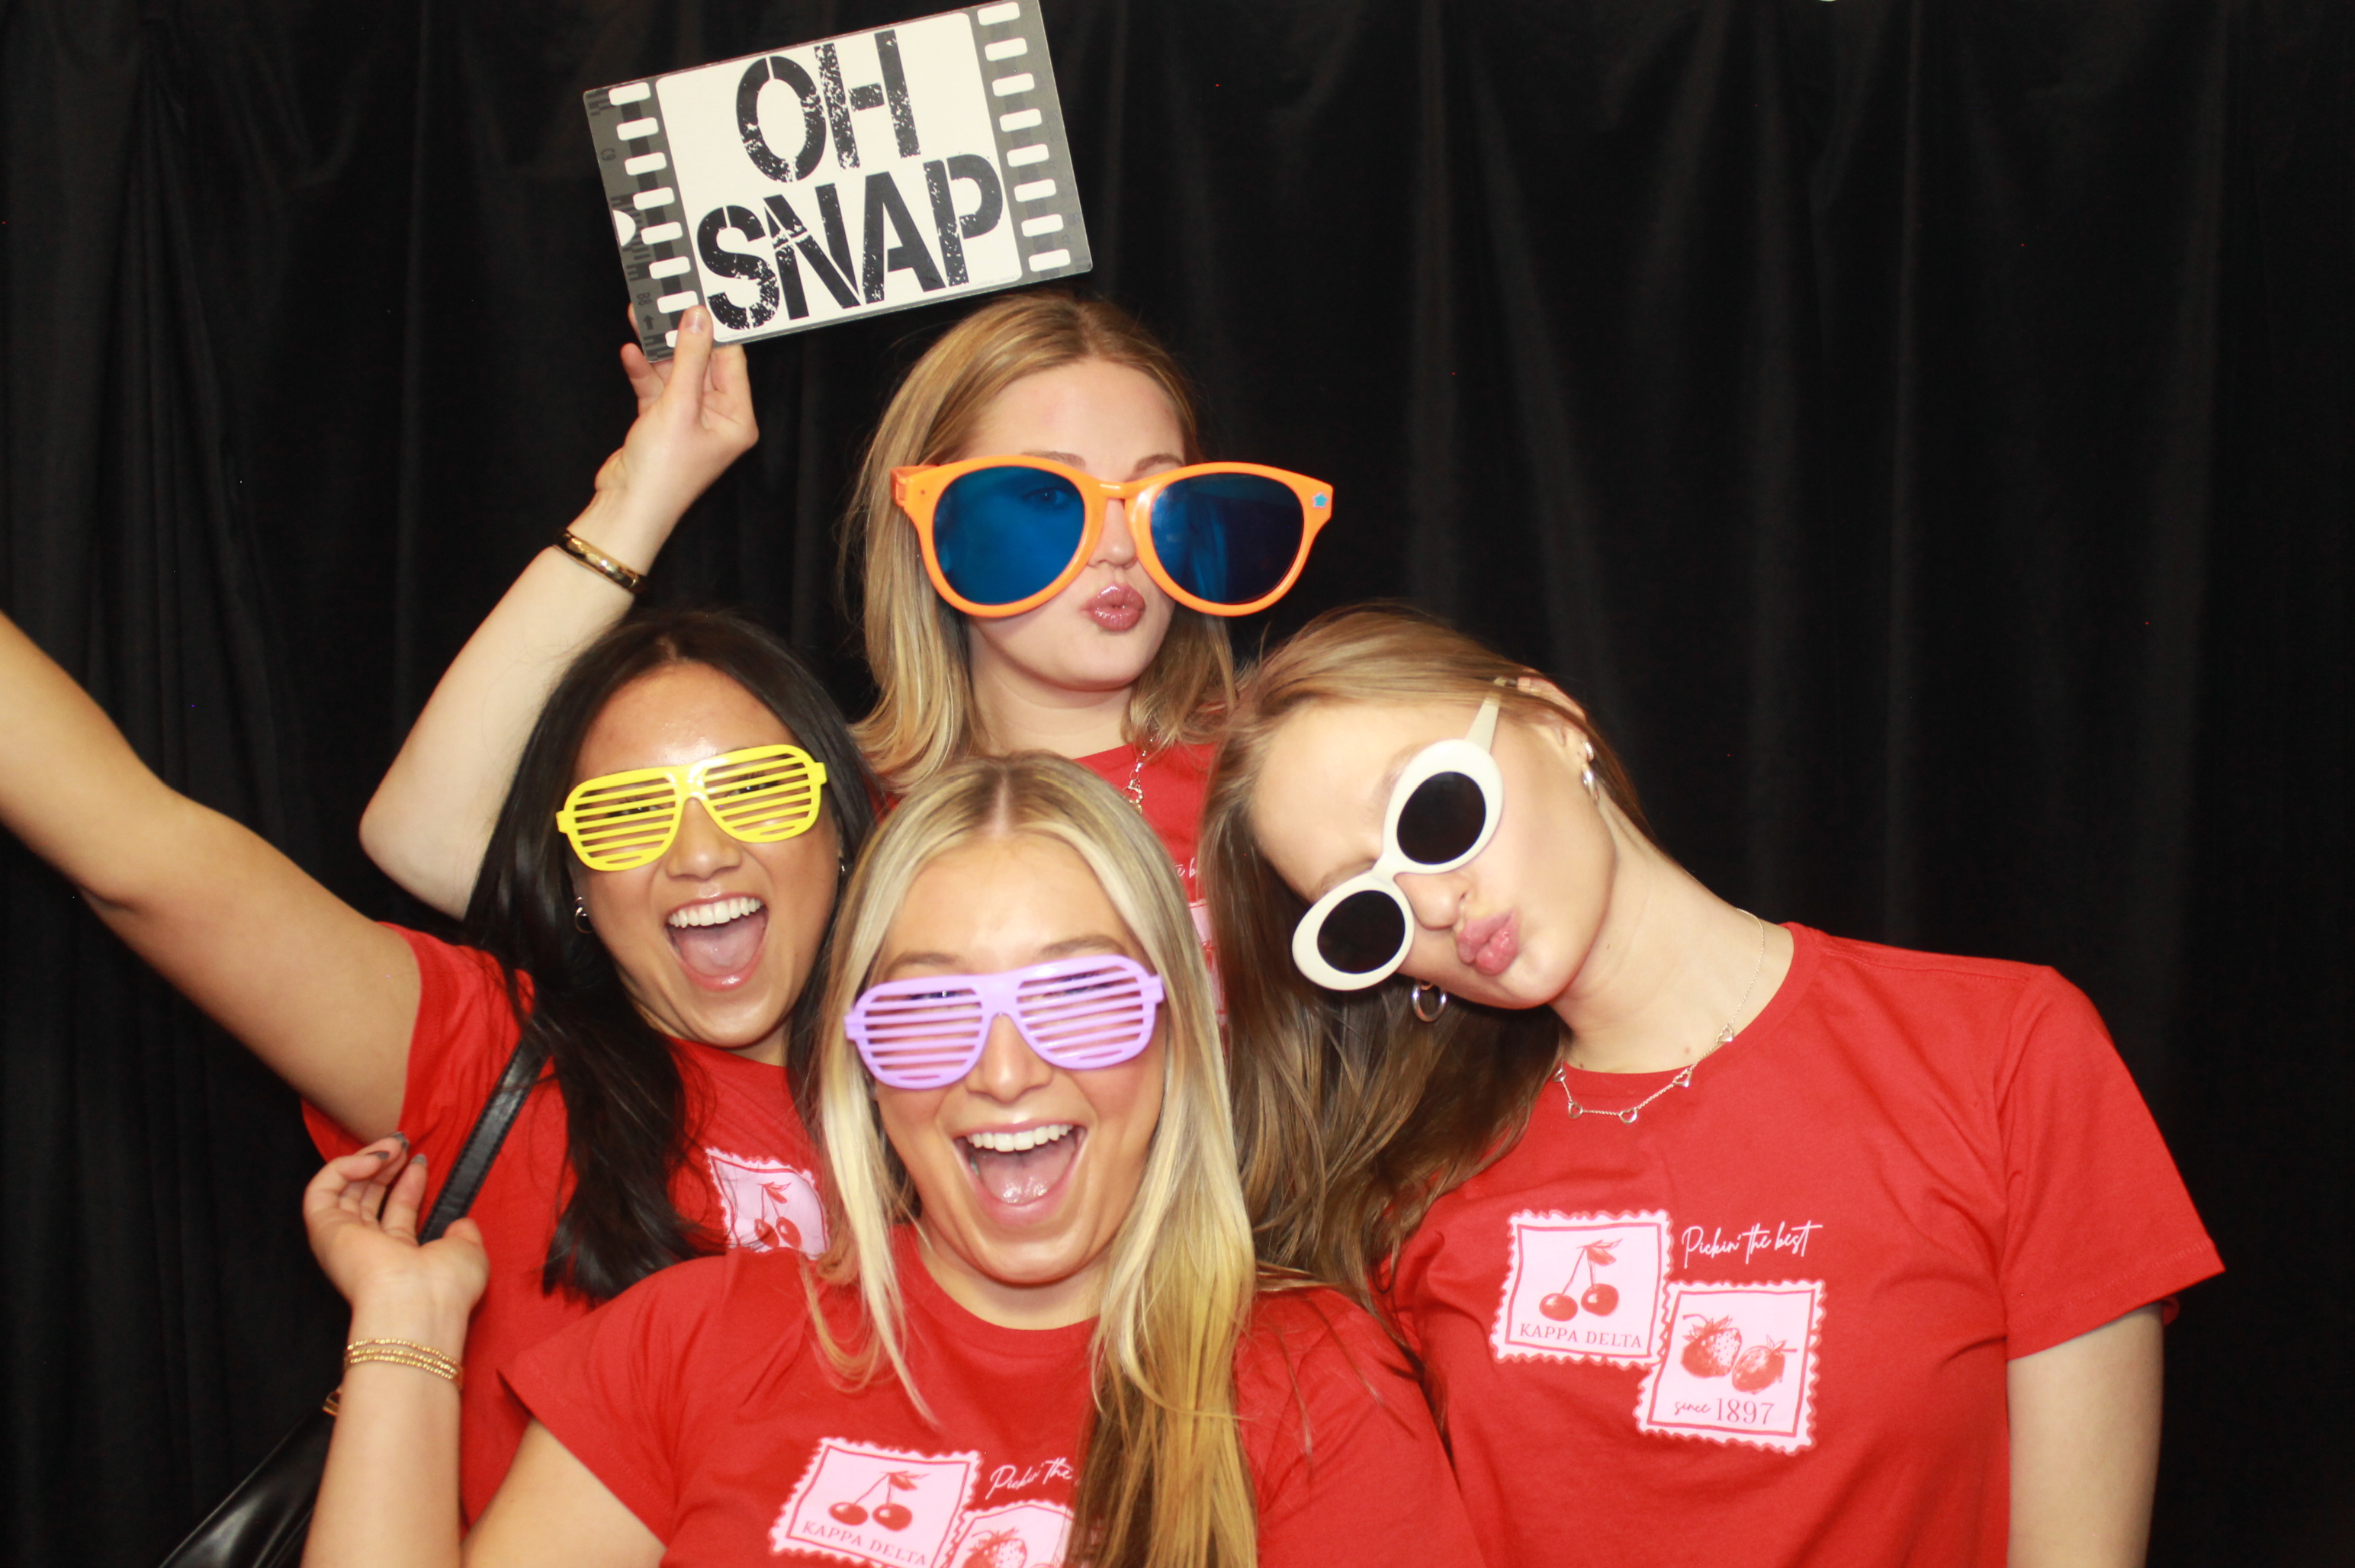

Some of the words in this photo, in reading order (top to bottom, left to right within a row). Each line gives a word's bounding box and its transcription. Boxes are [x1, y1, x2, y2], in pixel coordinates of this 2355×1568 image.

[736, 29, 921, 183] OH
[696, 153, 1004, 330] SNAP
[1742, 1223, 1772, 1264] the
[1774, 1220, 1823, 1257] best
[1519, 1323, 1579, 1343] KAPPA
[1585, 1331, 1643, 1348] DELTA
[1674, 1401, 1711, 1416] since
[1715, 1398, 1775, 1425] 1897
[802, 1521, 862, 1547] KAPPA
[869, 1539, 925, 1565] DELTA
